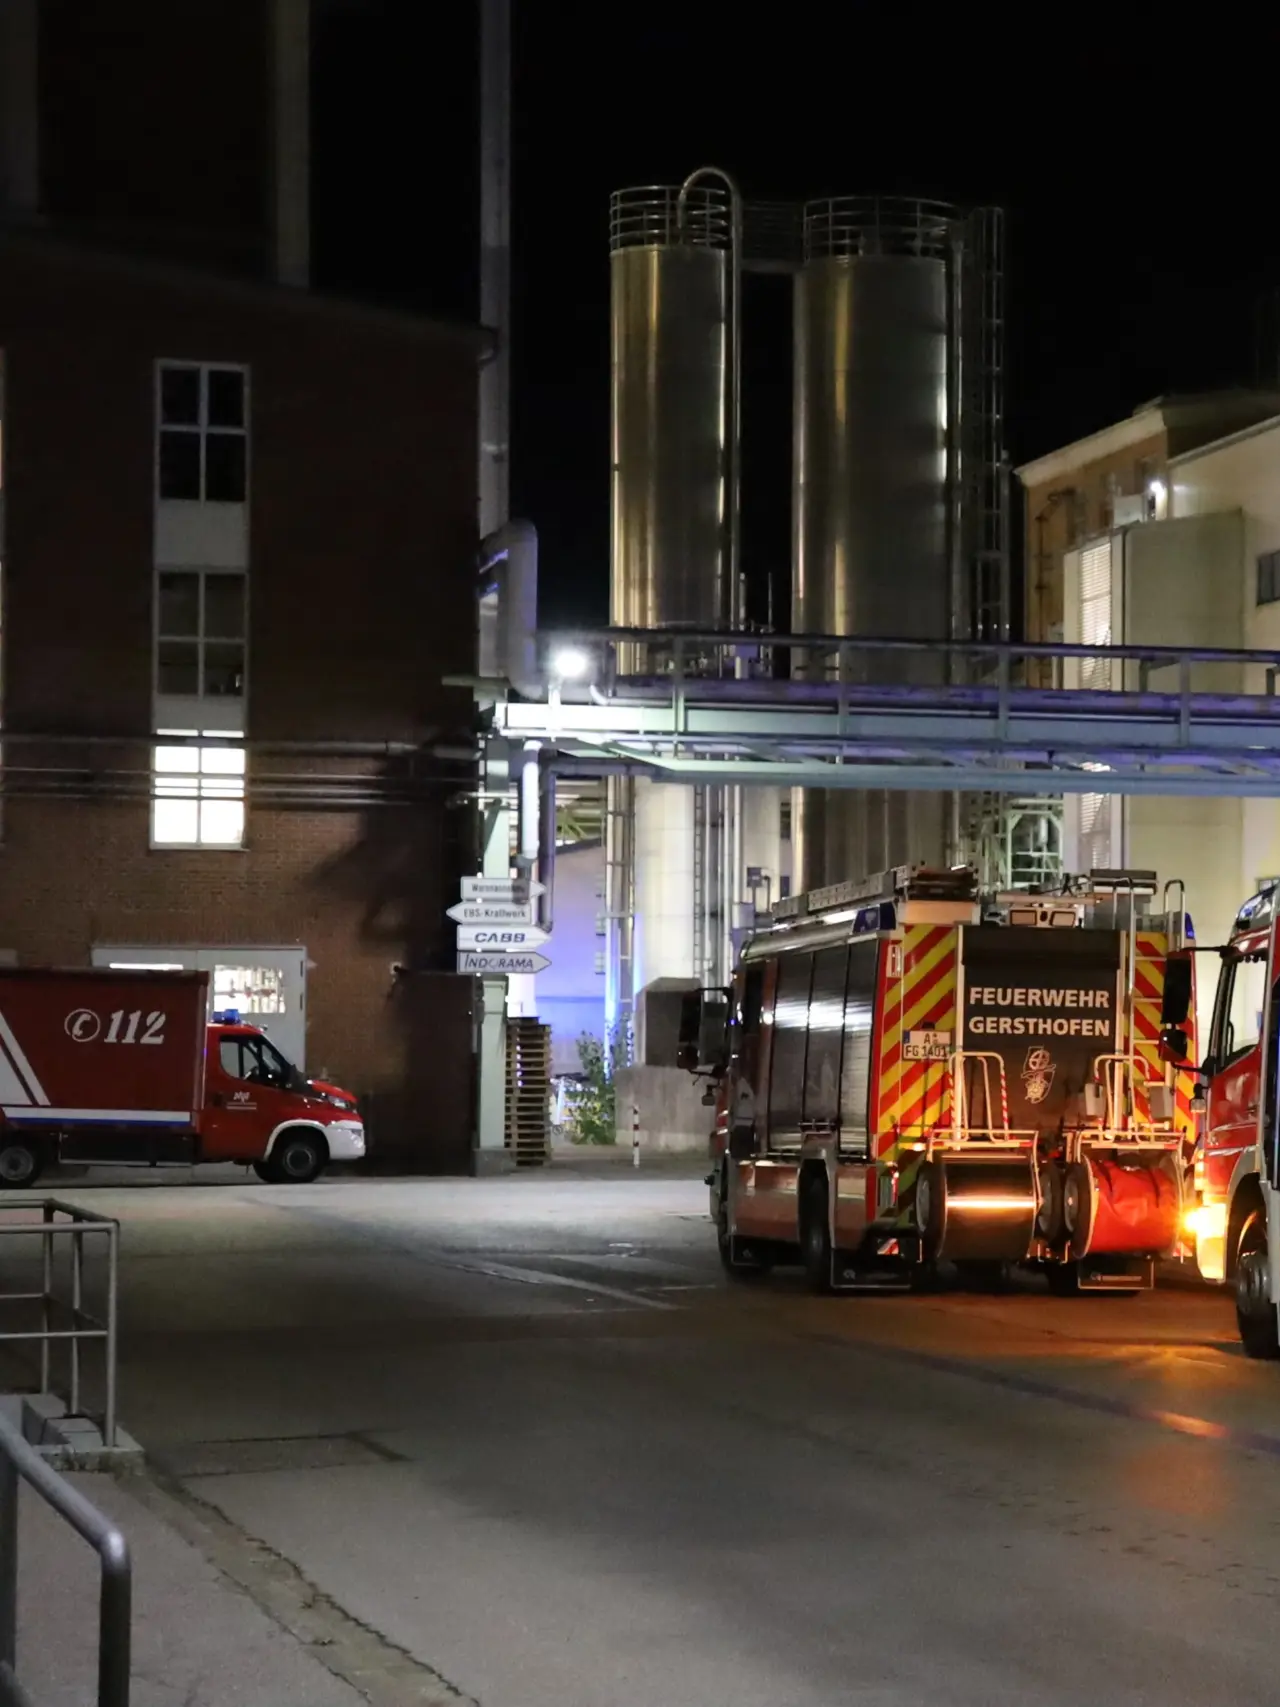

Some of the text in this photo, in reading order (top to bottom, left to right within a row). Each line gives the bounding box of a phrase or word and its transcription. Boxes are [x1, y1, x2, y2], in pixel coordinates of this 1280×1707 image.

[474, 932, 526, 944] CABB
[969, 987, 1110, 1009] FEUERWEHR
[103, 1009, 167, 1045] 112
[968, 1016, 1110, 1037] GERSTHOFEN
[923, 1032, 931, 1045] A
